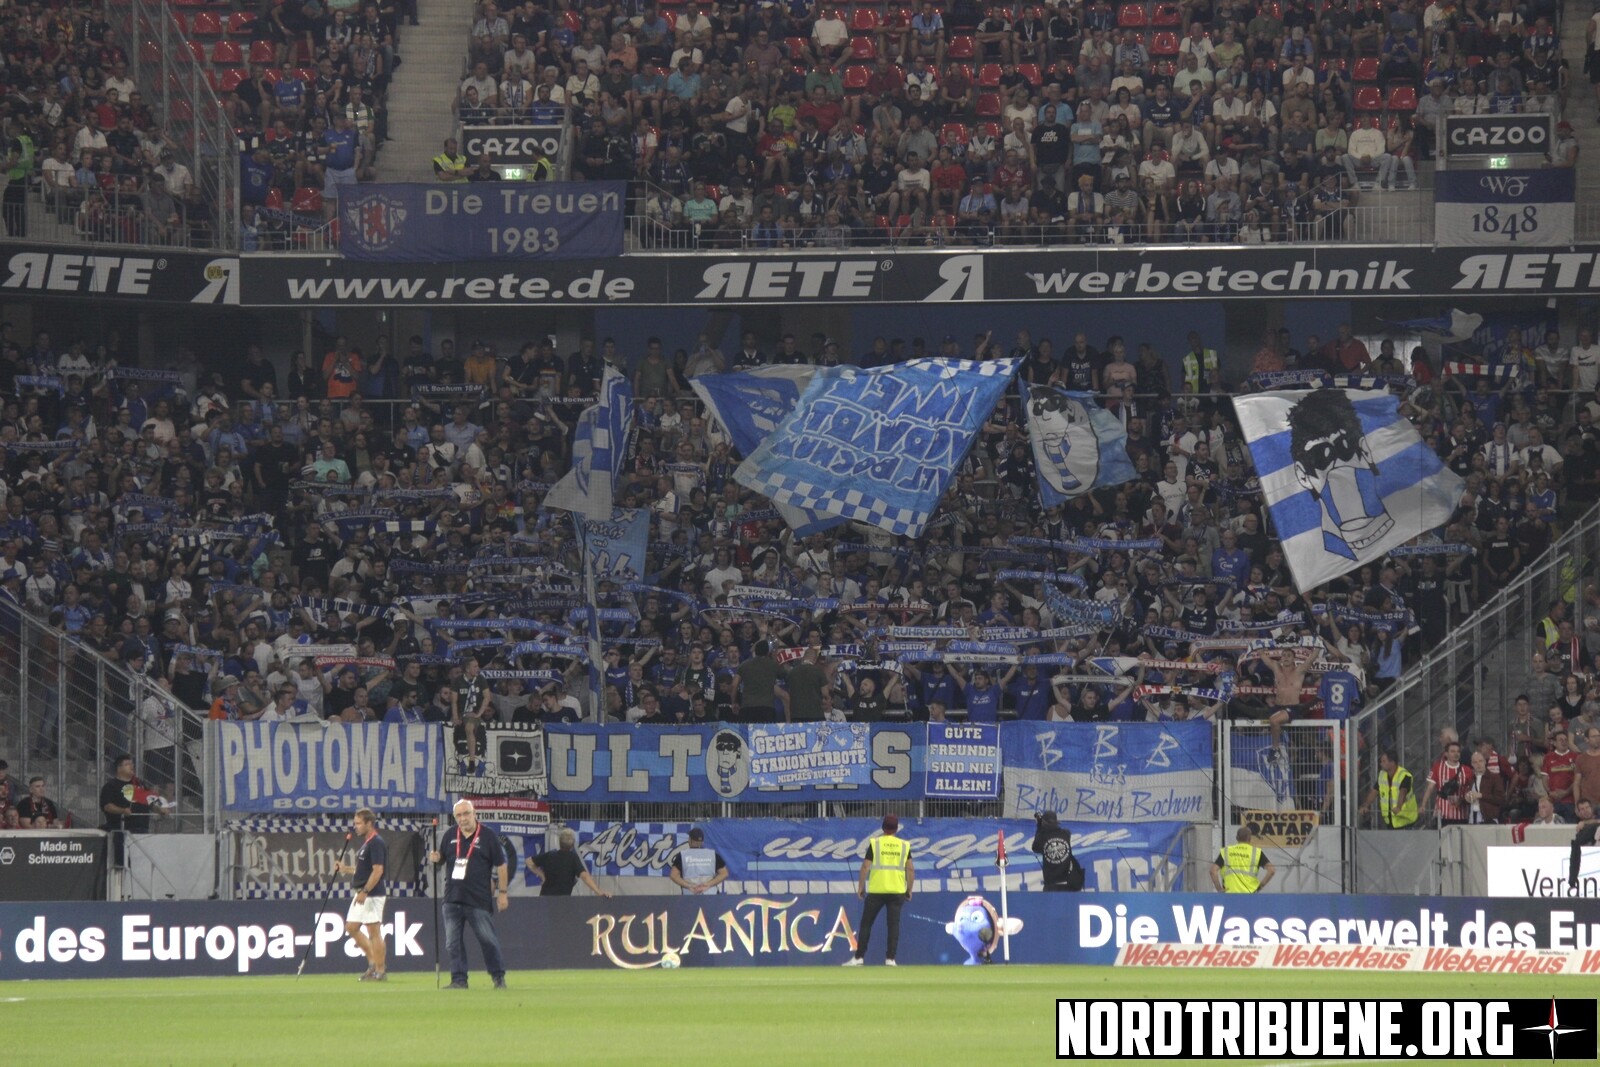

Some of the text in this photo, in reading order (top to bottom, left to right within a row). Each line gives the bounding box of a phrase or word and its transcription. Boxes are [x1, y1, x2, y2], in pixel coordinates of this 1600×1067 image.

[467, 137, 559, 156] CAZOO
[1450, 126, 1547, 146] CAZOO
[425, 189, 619, 215] Die Treuen
[1471, 205, 1539, 241] 1848
[488, 227, 559, 253] 1983
[287, 269, 636, 302] www.rete.de
[1034, 260, 1415, 294] werbetechnik
[893, 627, 968, 637] RUHRSTADIO
[480, 669, 553, 679] ANGENDREER
[1331, 683, 1345, 705] 8
[754, 732, 808, 754] GEGEN
[944, 727, 982, 740] GUTE
[929, 744, 997, 758] FREUNDE
[1035, 730, 1063, 772] B
[1094, 724, 1119, 765] B
[750, 748, 868, 774] STADIONVERBOTE
[931, 761, 994, 775] SIND NIE
[1089, 762, 1128, 787] 1848
[934, 779, 992, 793] ALLEIN!
[272, 795, 416, 810] BOCHUM
[1075, 787, 1125, 819] Boys
[1131, 787, 1203, 819] Bochum
[475, 811, 549, 823] TION LUXEMBURG
[1245, 812, 1315, 822] #BOYCOTT
[1245, 822, 1314, 838] QATAR
[40, 841, 82, 851] Made im
[28, 853, 93, 864] Schwarzwald
[586, 896, 858, 969] RULANTICA
[1079, 903, 1158, 948] Die
[1172, 904, 1449, 949] Wasserwelt
[1460, 910, 1536, 950] des
[15, 915, 105, 962] des
[1122, 943, 1260, 968] WeberHaus
[1271, 944, 1411, 971] WeberHaus
[1422, 947, 1568, 974] WeberHaus
